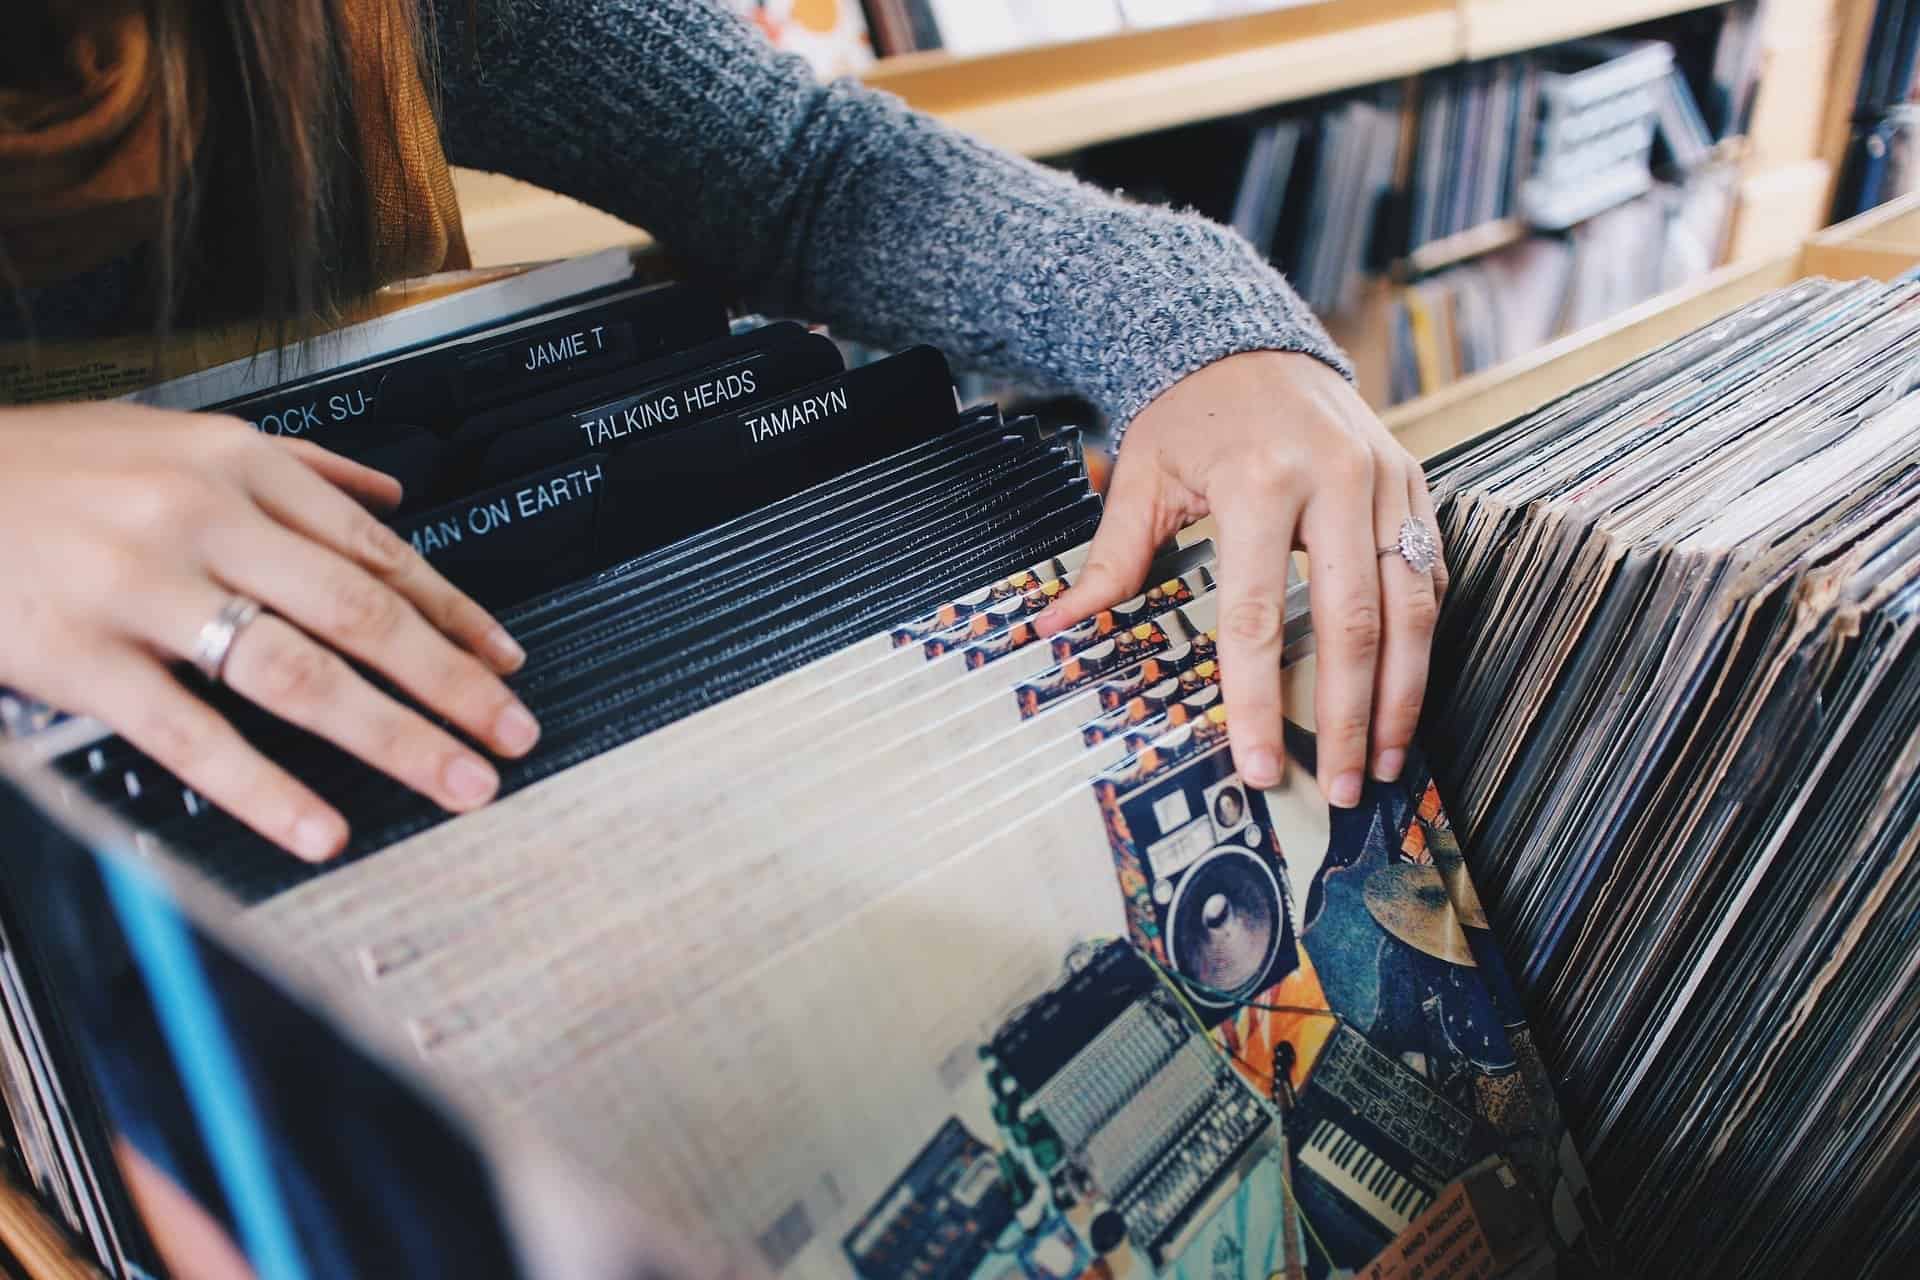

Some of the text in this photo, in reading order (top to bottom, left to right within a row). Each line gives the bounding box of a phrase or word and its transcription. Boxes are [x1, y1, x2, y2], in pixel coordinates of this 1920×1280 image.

[525, 325, 604, 371] JAMIE T
[247, 389, 374, 437] OCK SU-
[580, 369, 758, 447] TALKING HEADS
[744, 387, 849, 444] TAMARYN
[467, 498, 512, 535] ON
[514, 463, 603, 518] EARTH
